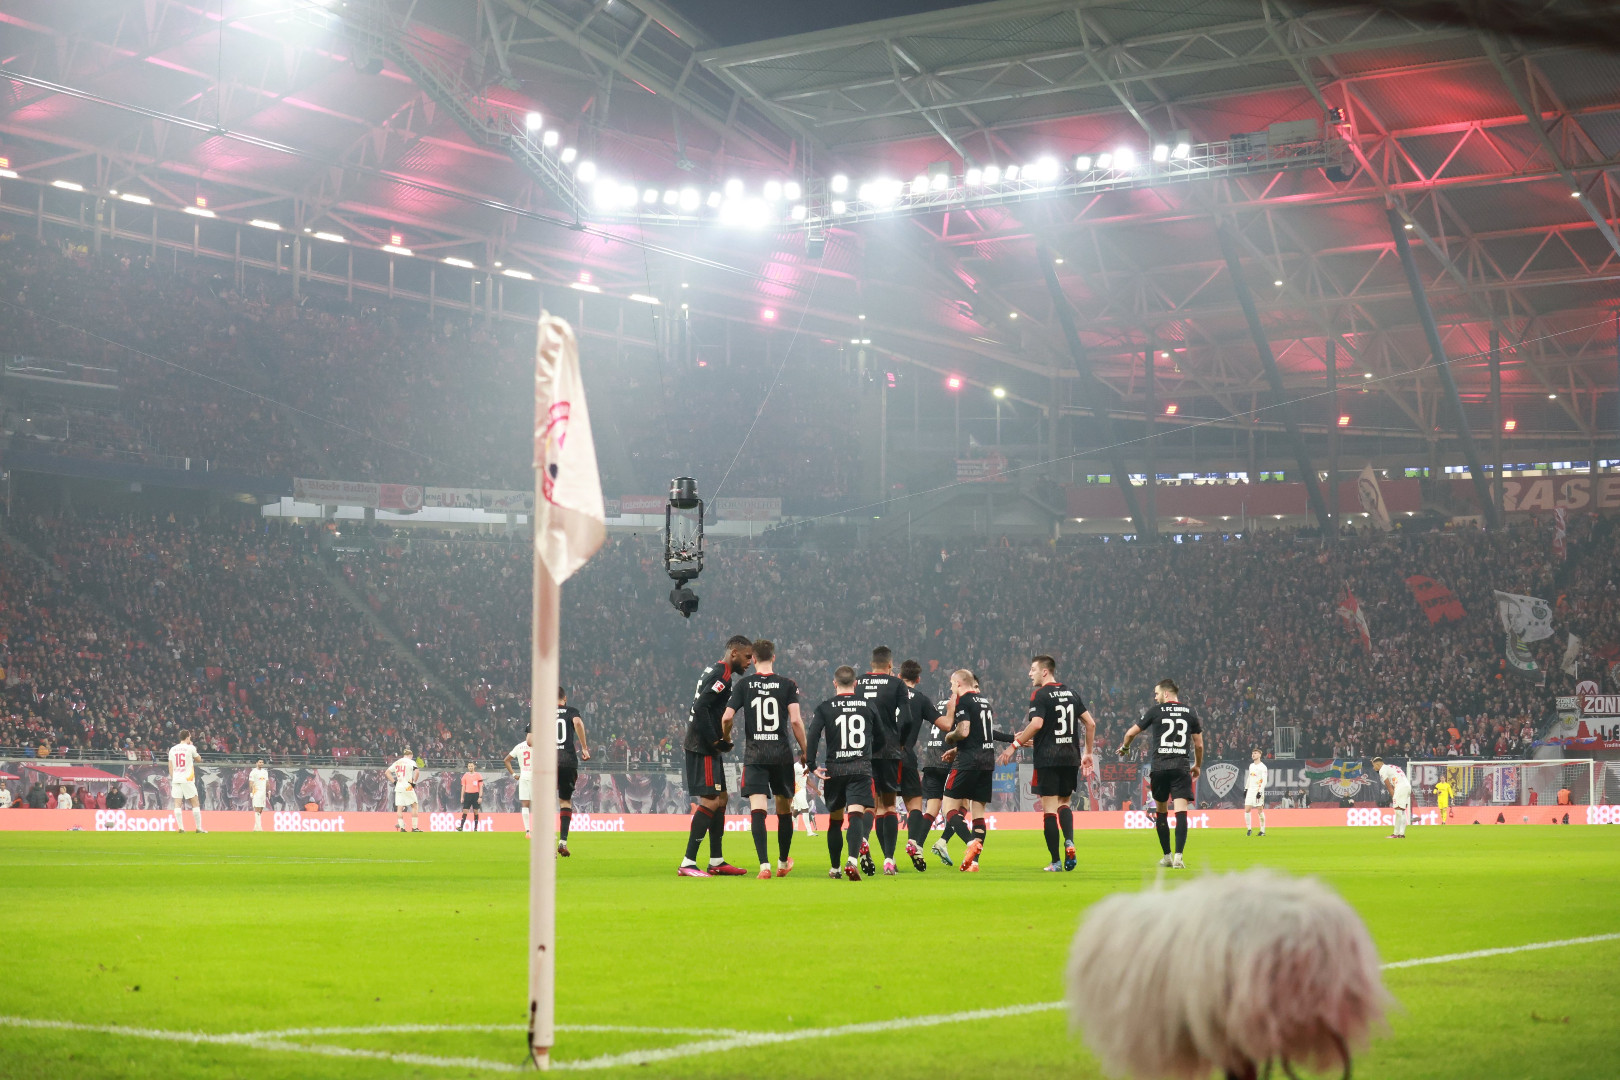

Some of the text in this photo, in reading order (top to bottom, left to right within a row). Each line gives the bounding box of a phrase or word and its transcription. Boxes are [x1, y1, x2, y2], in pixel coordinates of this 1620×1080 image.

[762, 682, 780, 690] UNION
[751, 696, 779, 732] 19
[1584, 697, 1620, 713] ZON
[834, 714, 866, 750] 18
[980, 710, 994, 741] 11
[1054, 703, 1074, 736] 31
[1160, 718, 1188, 748] 23
[175, 753, 186, 768] 16
[95, 810, 175, 831] 888sport
[274, 811, 345, 832] 888sport
